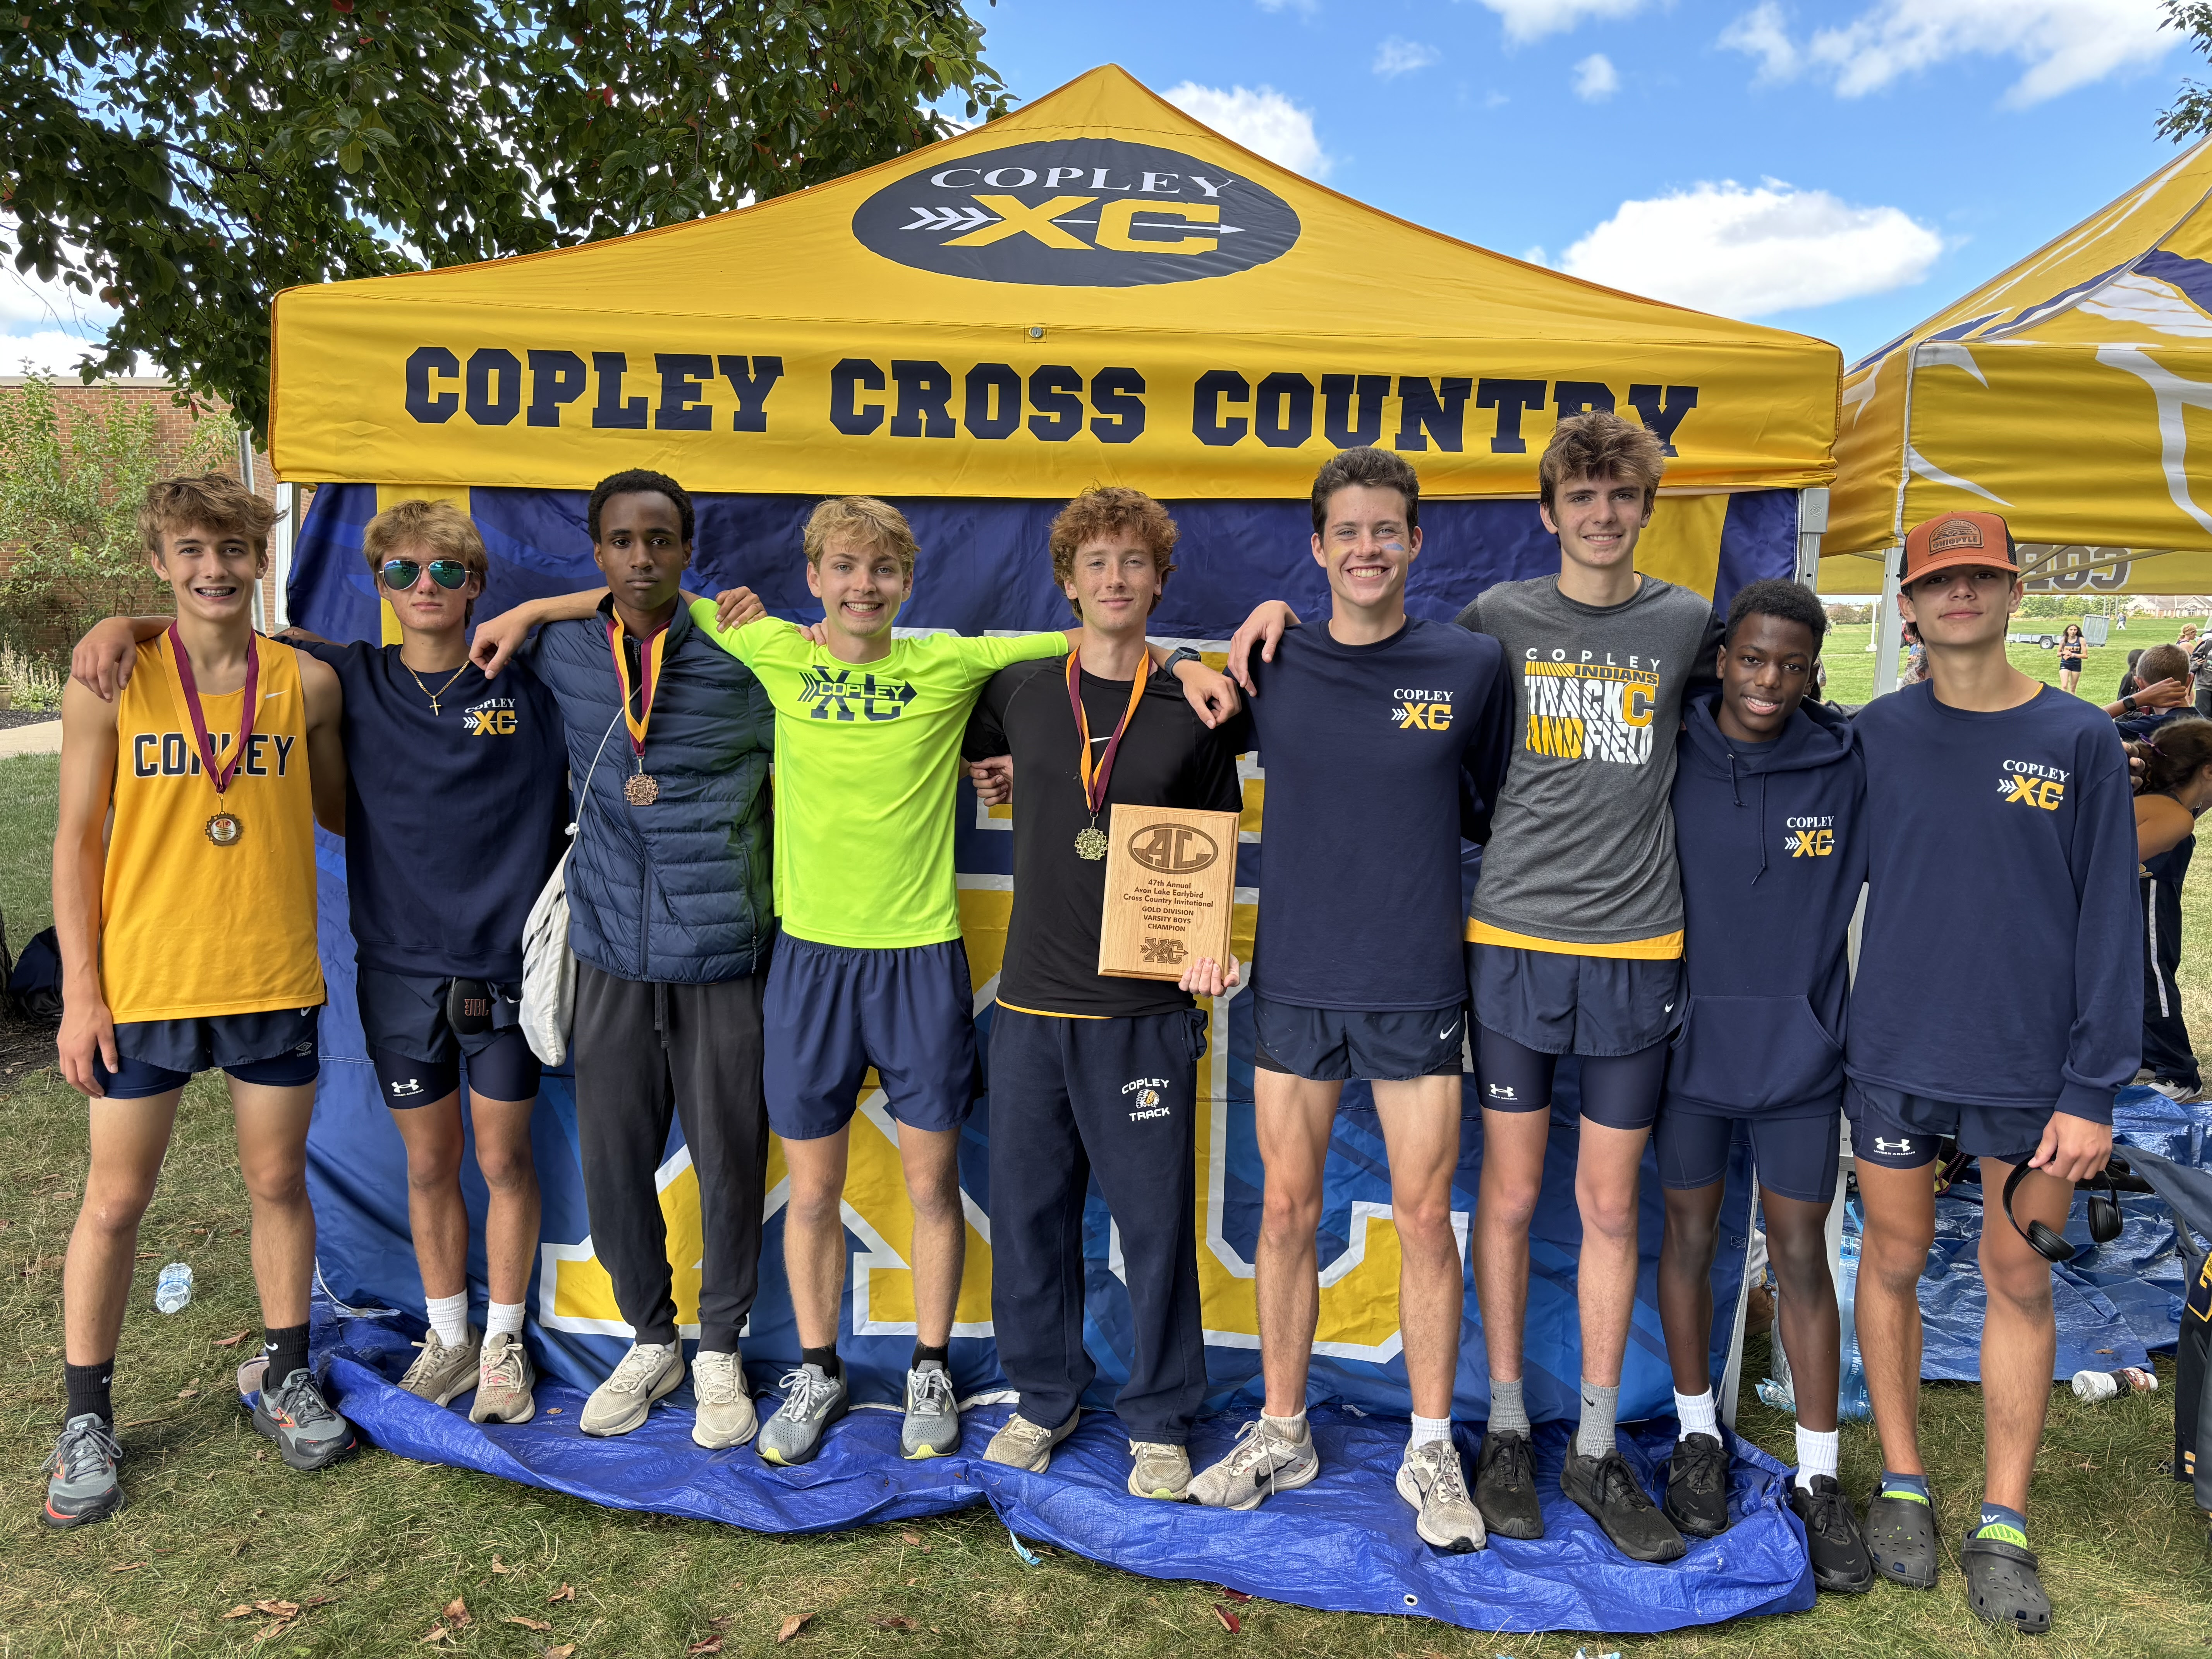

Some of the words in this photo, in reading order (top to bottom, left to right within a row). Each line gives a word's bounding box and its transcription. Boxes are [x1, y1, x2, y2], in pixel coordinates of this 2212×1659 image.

[931, 167, 1237, 197] COPLEY
[939, 194, 1220, 256] XC
[405, 346, 784, 432] COPLEY
[830, 357, 1146, 443] CROSS
[1933, 536, 1977, 549] OHIOPYLE
[1526, 647, 1660, 672] COPLEY
[1574, 665, 1657, 684] INDIANS
[818, 682, 905, 700] COPLEY
[1393, 689, 1453, 701] COPLEY
[1524, 675, 1625, 723] TRACK
[464, 698, 515, 713] COPLEY
[1621, 680, 1656, 727] C
[472, 710, 515, 735] XC
[1399, 702, 1451, 730] XC
[1525, 714, 1583, 759] AND
[2003, 760, 2070, 782] COPLEY
[2005, 775, 2064, 811] XC
[1786, 816, 1834, 828] COPLEY
[1133, 829, 1212, 869] AL
[1792, 829, 1832, 857] XC
[1154, 888, 1170, 896] Lake
[1173, 889, 1204, 899] Earlybird
[1166, 880, 1191, 889] Annual
[1123, 893, 1142, 902] Cross
[1145, 895, 1172, 905] Country
[1174, 897, 1213, 907] Invitational
[1144, 914, 1171, 922] VARSITY
[1163, 908, 1194, 916] DIVISION
[1147, 923, 1185, 932] CHAMPION
[1143, 937, 1184, 964] XC
[465, 999, 489, 1016] JBL
[1121, 1077, 1170, 1094] COPLEY
[1128, 1107, 1170, 1122] TRACK
[1850, 1357, 1862, 1376] Water
